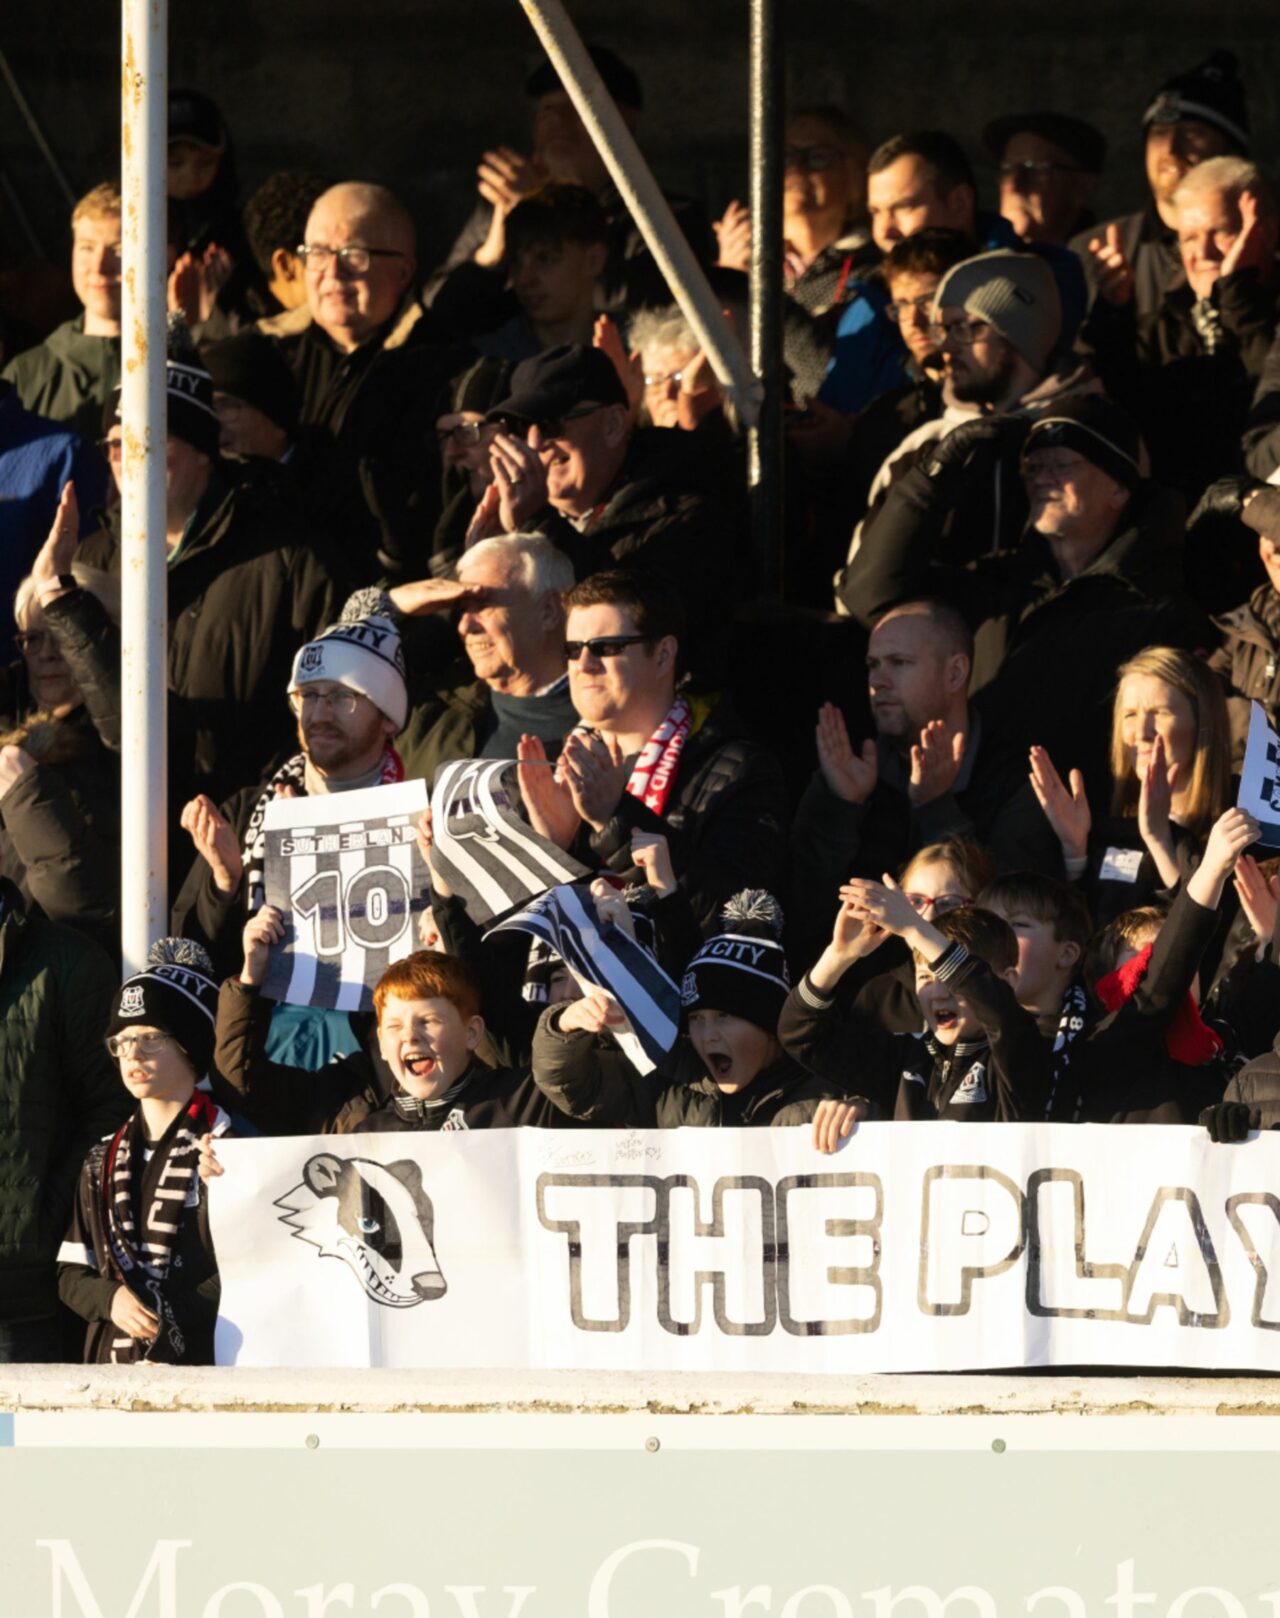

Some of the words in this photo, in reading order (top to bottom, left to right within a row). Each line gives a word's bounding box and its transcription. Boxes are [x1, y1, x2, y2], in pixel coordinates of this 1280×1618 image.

[166, 368, 200, 395] ITY
[290, 865, 412, 957] 10
[154, 966, 209, 996] CITY
[711, 941, 767, 967] CITY
[146, 1127, 199, 1235] CITY
[535, 1171, 884, 1337] THE
